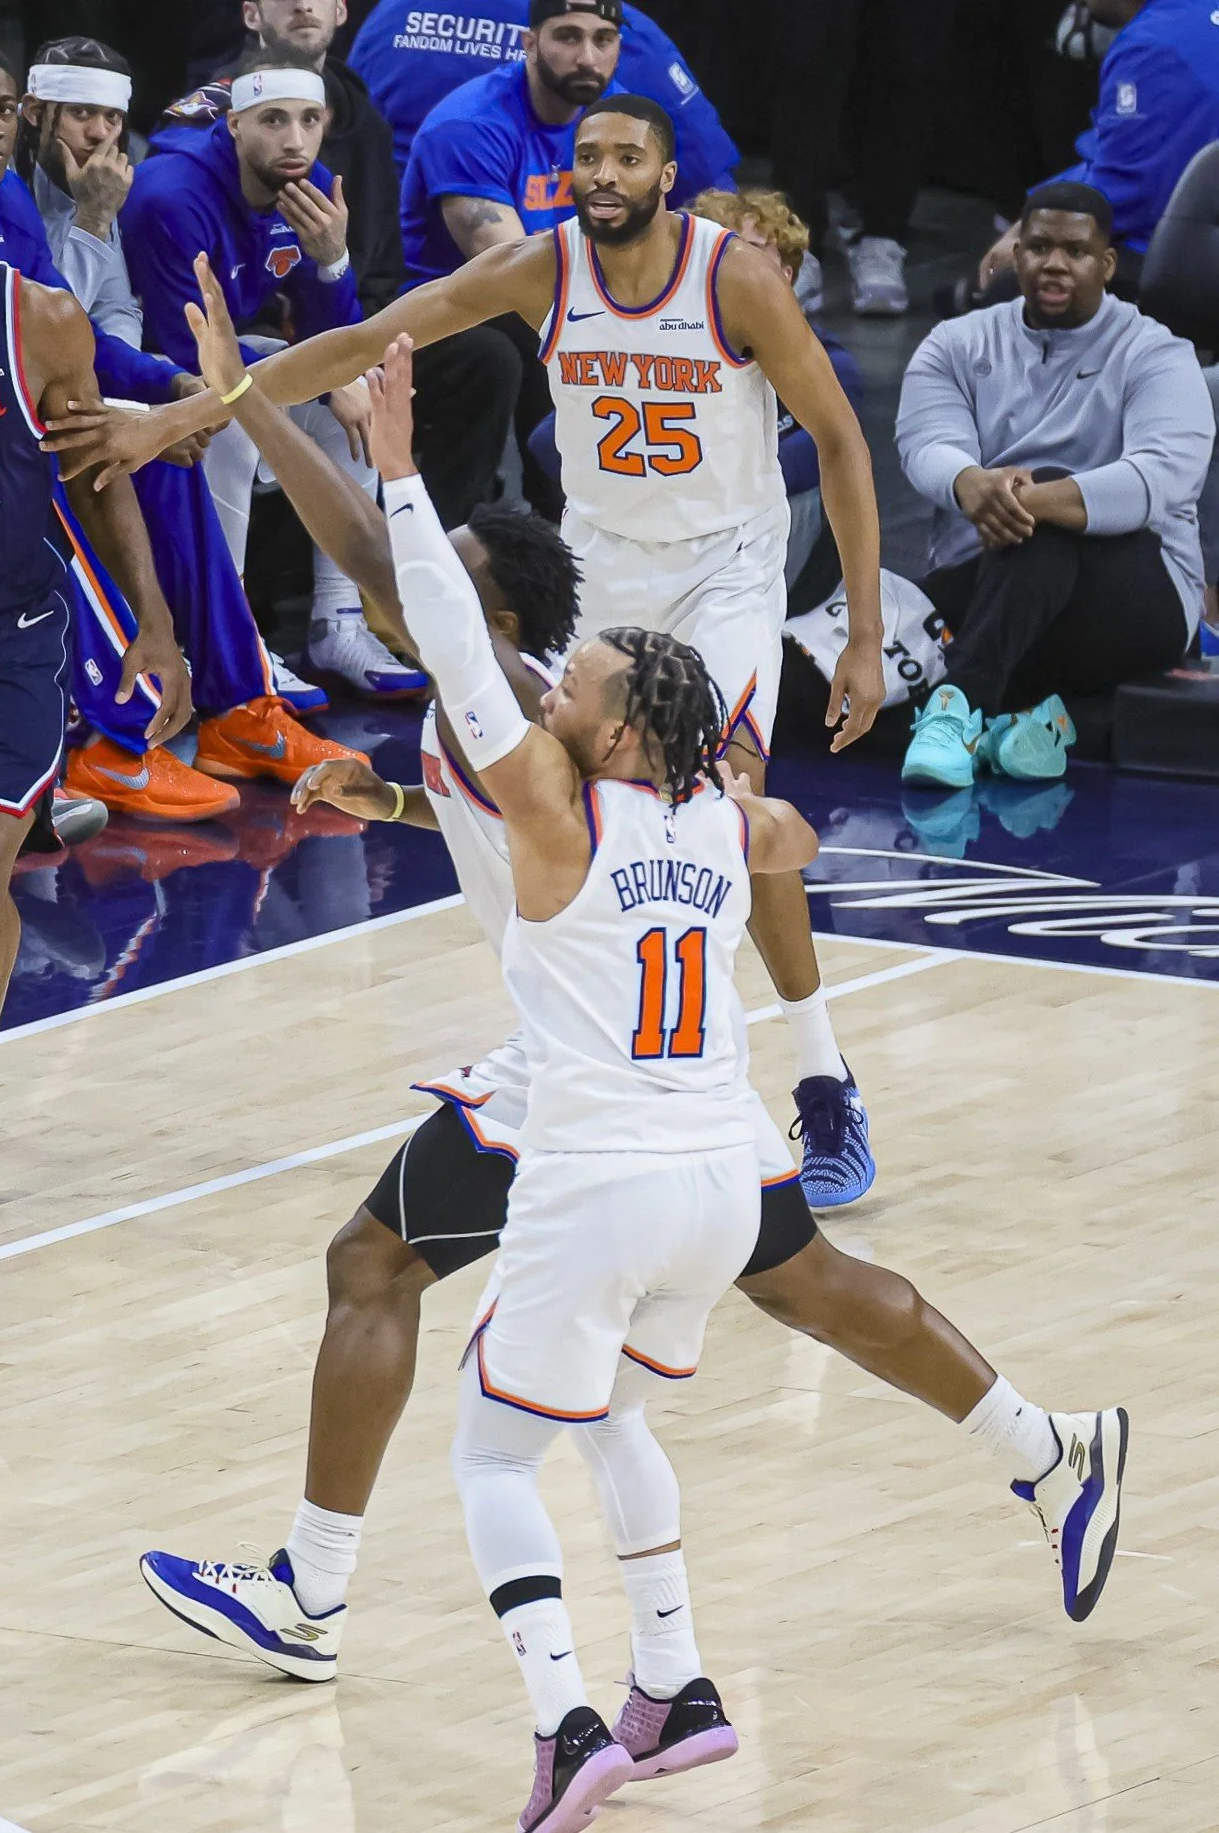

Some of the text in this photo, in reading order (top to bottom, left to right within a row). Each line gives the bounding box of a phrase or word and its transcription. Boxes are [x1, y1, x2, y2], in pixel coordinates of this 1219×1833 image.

[393, 34, 453, 53] FANDOM
[455, 40, 501, 59] LIVES
[406, 11, 530, 46] SECURIT
[659, 321, 704, 331] abu dhabi
[557, 351, 723, 393] NEW YORK
[591, 395, 703, 477] 25
[610, 859, 733, 919] BRUNSON
[631, 926, 707, 1060] 11
